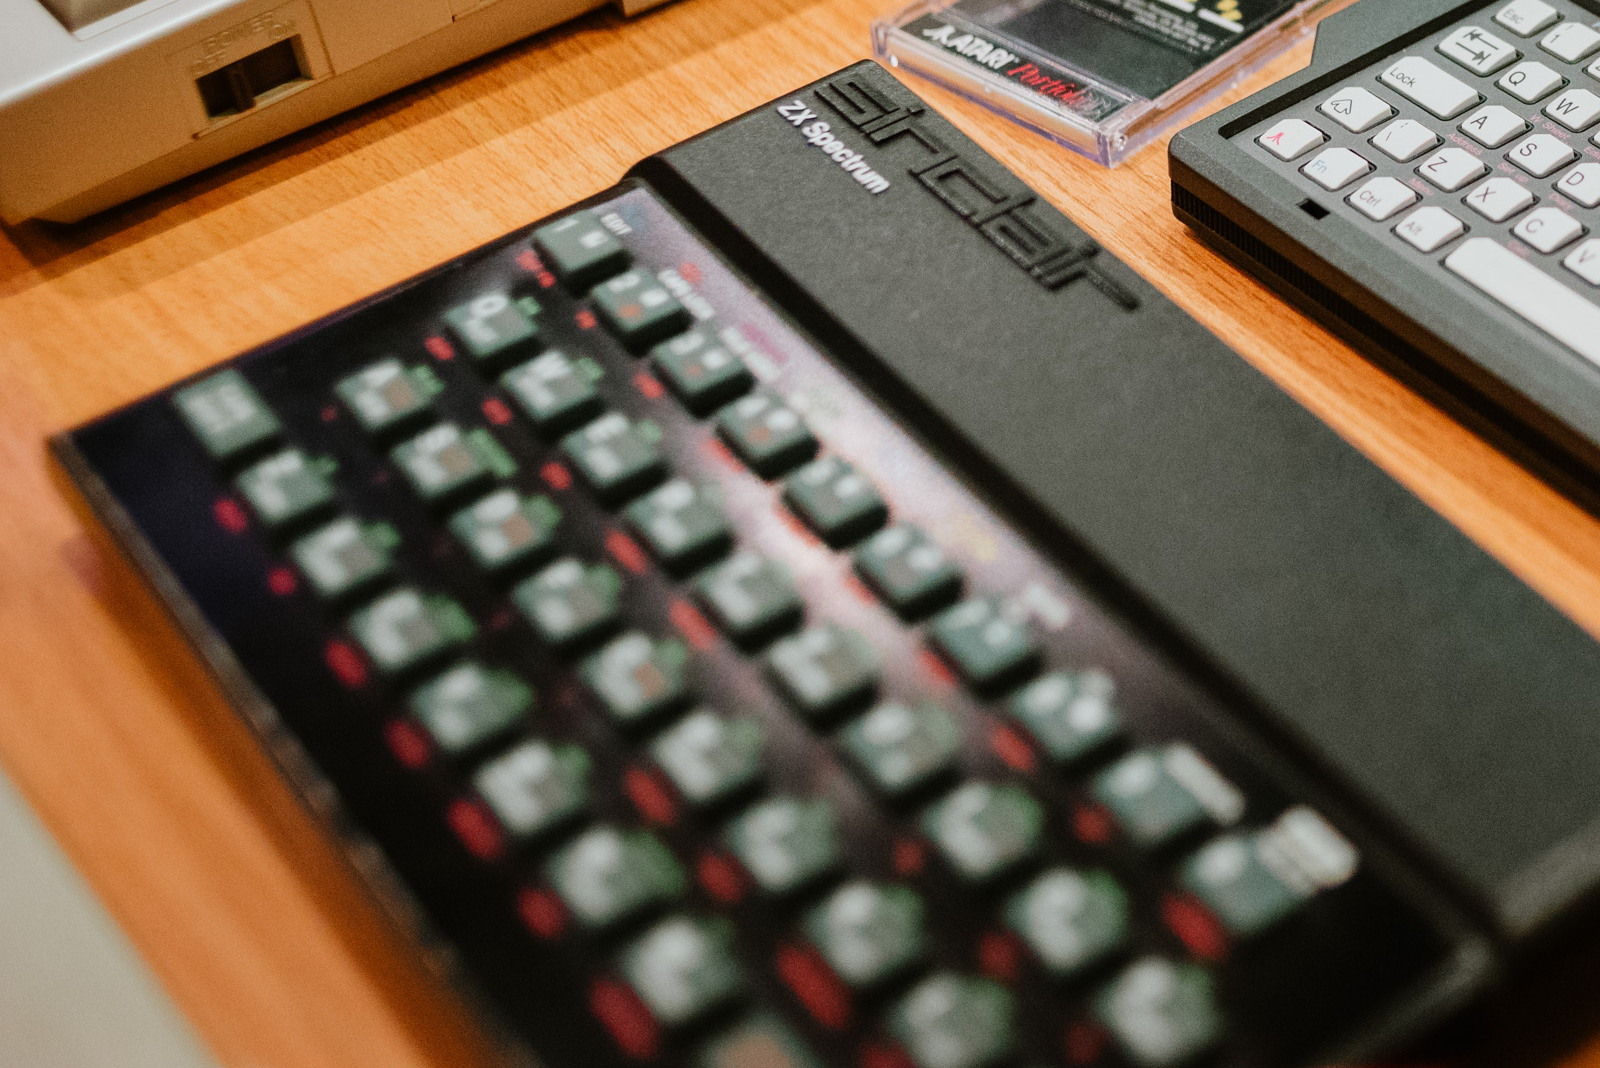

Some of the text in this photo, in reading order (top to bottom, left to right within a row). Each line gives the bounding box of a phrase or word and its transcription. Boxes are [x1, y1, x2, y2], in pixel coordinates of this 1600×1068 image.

[1502, 8, 1525, 25] Esc
[1550, 34, 1560, 44] 1
[952, 34, 1016, 70] ATARI
[1389, 66, 1416, 88] Lock
[1508, 71, 1526, 86] Q
[1555, 97, 1580, 115] W
[1470, 115, 1489, 130] A
[1542, 121, 1571, 141] Sheet
[776, 100, 891, 196] ZX Spectrum
[1447, 132, 1482, 156] Address
[1519, 142, 1538, 157] S
[1312, 159, 1328, 173] Fn
[1427, 156, 1448, 172] Z
[1565, 171, 1585, 186] D
[1359, 190, 1381, 207] Ctrl
[1475, 186, 1496, 203] X
[1404, 221, 1423, 236] Alt
[1525, 218, 1544, 234] C
[1576, 249, 1596, 264] V
